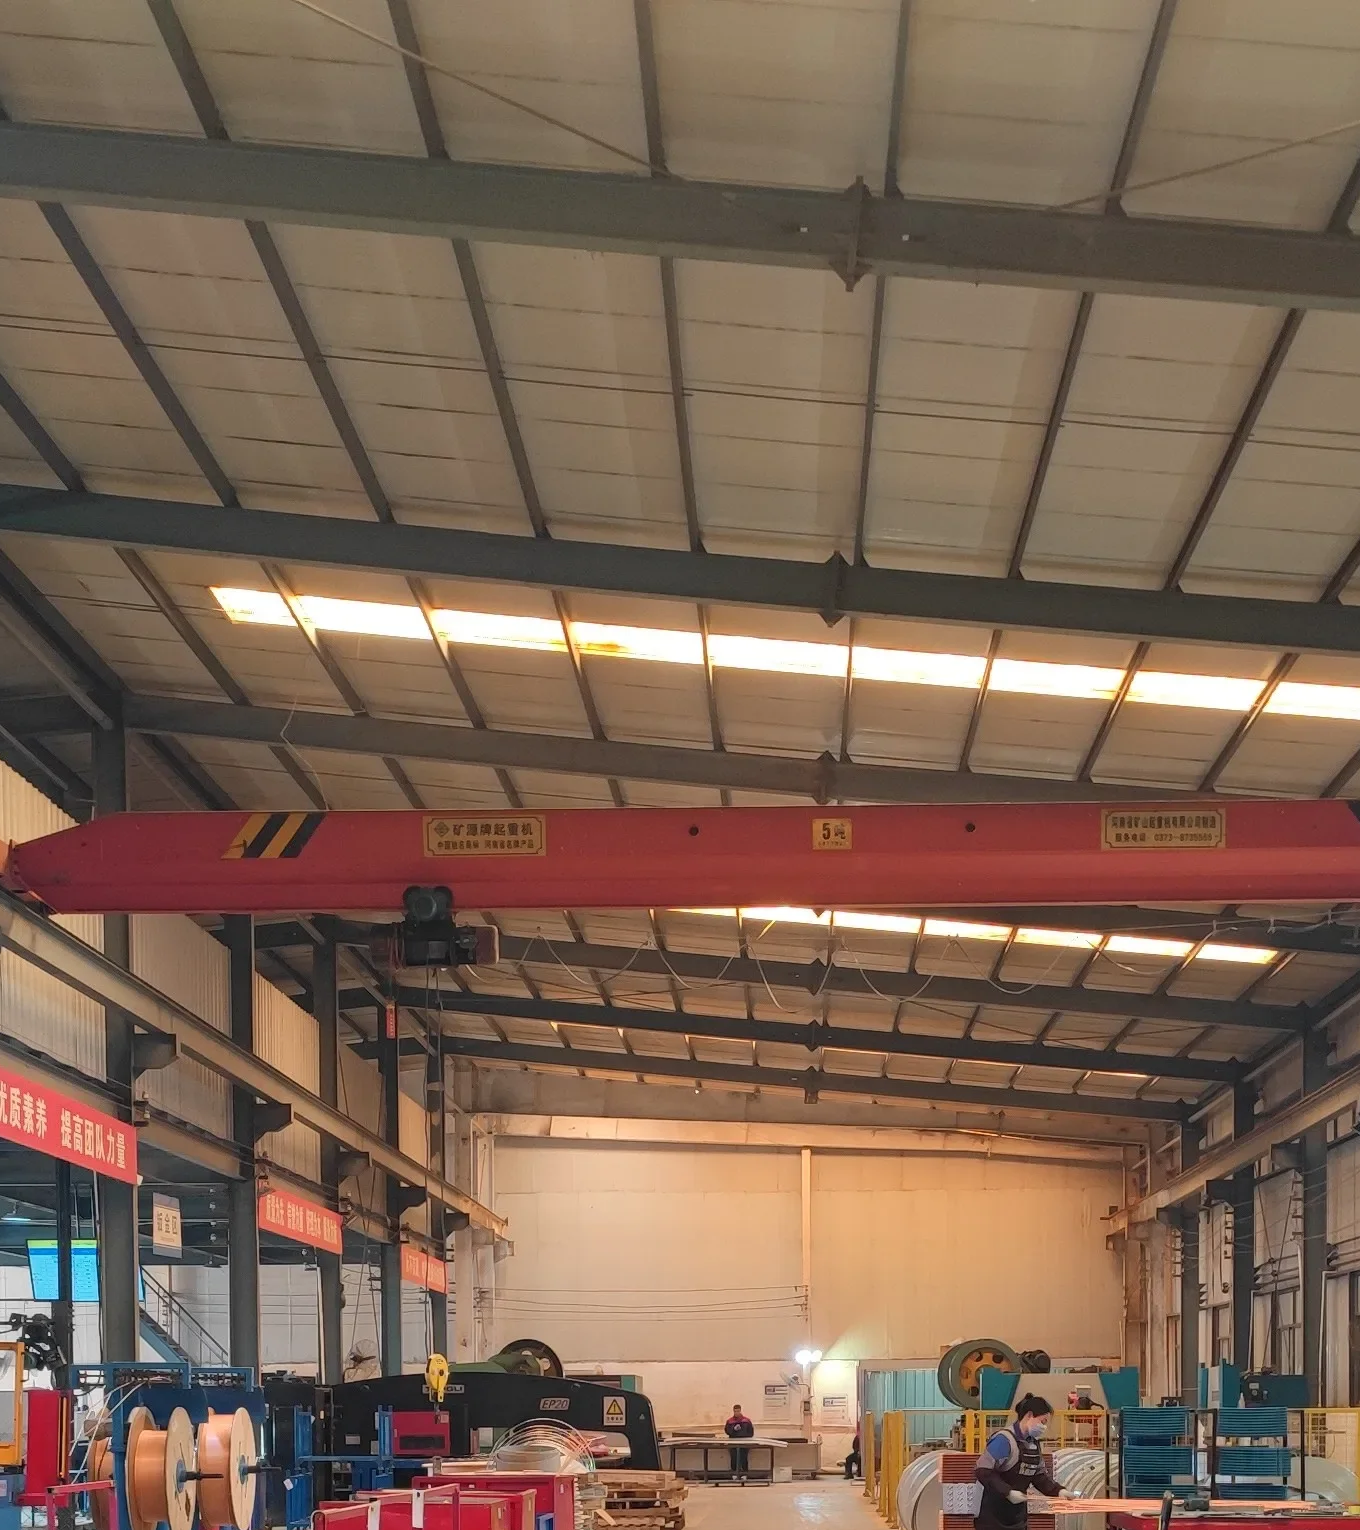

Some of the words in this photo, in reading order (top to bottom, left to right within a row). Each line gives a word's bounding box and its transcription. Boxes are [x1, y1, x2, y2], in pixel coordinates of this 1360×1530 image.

[452, 822, 533, 836] 矿源牌起重机
[60, 1108, 126, 1170] 提高团队力量
[542, 1399, 569, 1409] EP20
